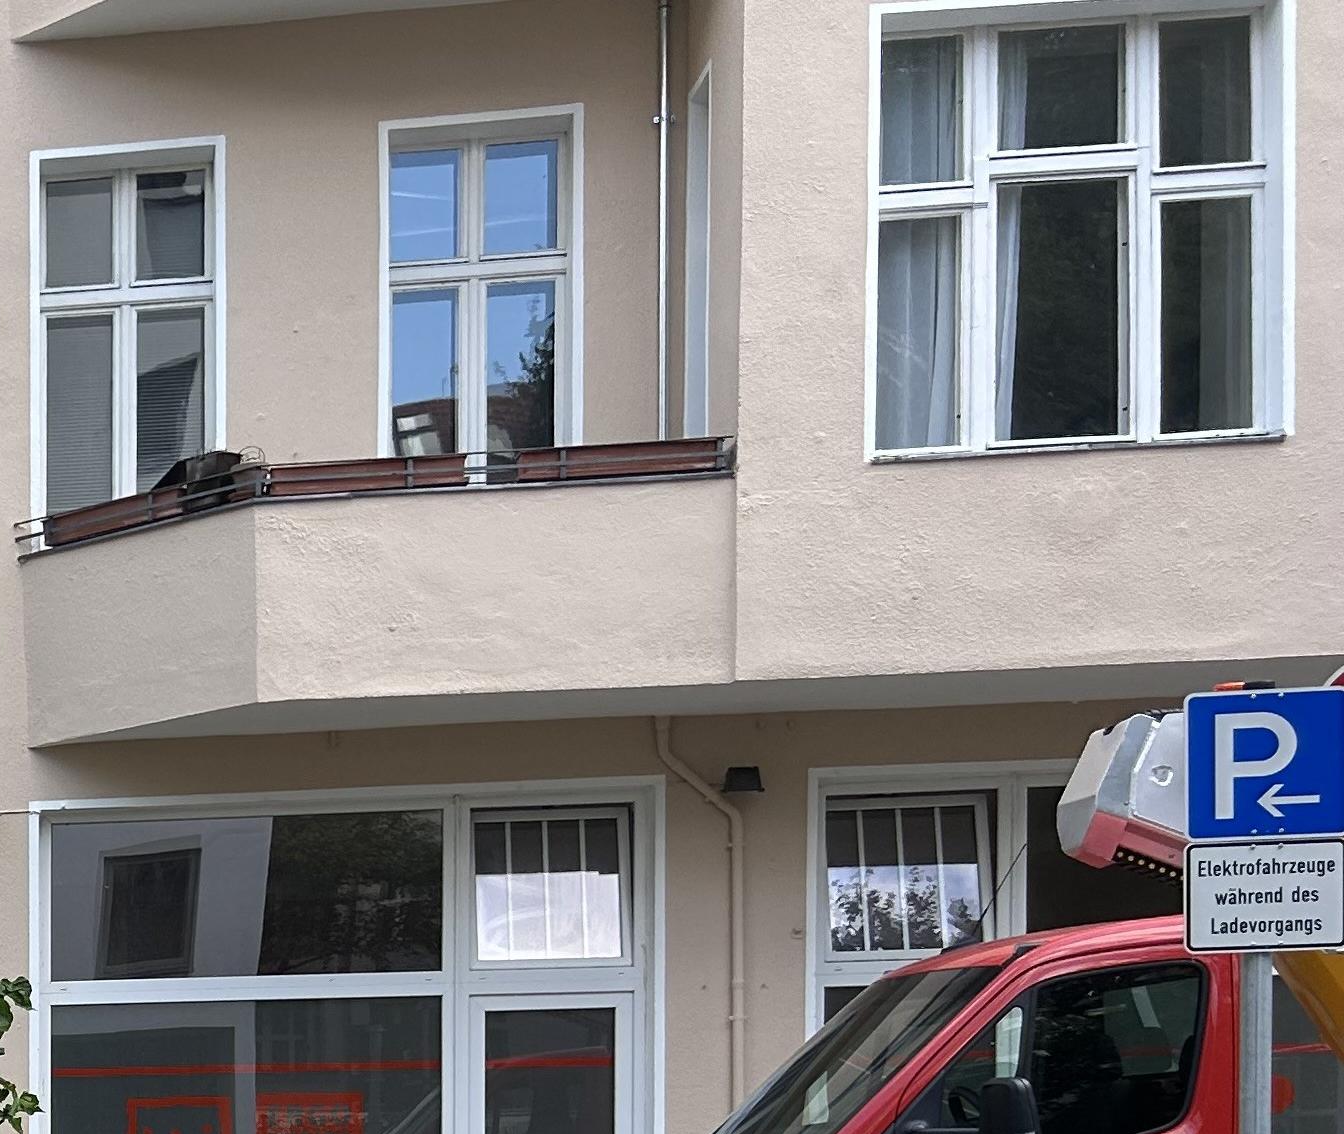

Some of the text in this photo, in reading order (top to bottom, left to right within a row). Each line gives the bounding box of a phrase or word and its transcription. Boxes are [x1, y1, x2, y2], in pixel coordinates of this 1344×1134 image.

[1214, 711, 1298, 820] P
[1197, 858, 1336, 877] Elektrofahrzeuge
[1215, 886, 1320, 905] während des
[1211, 916, 1323, 937] Ladevorgangs
